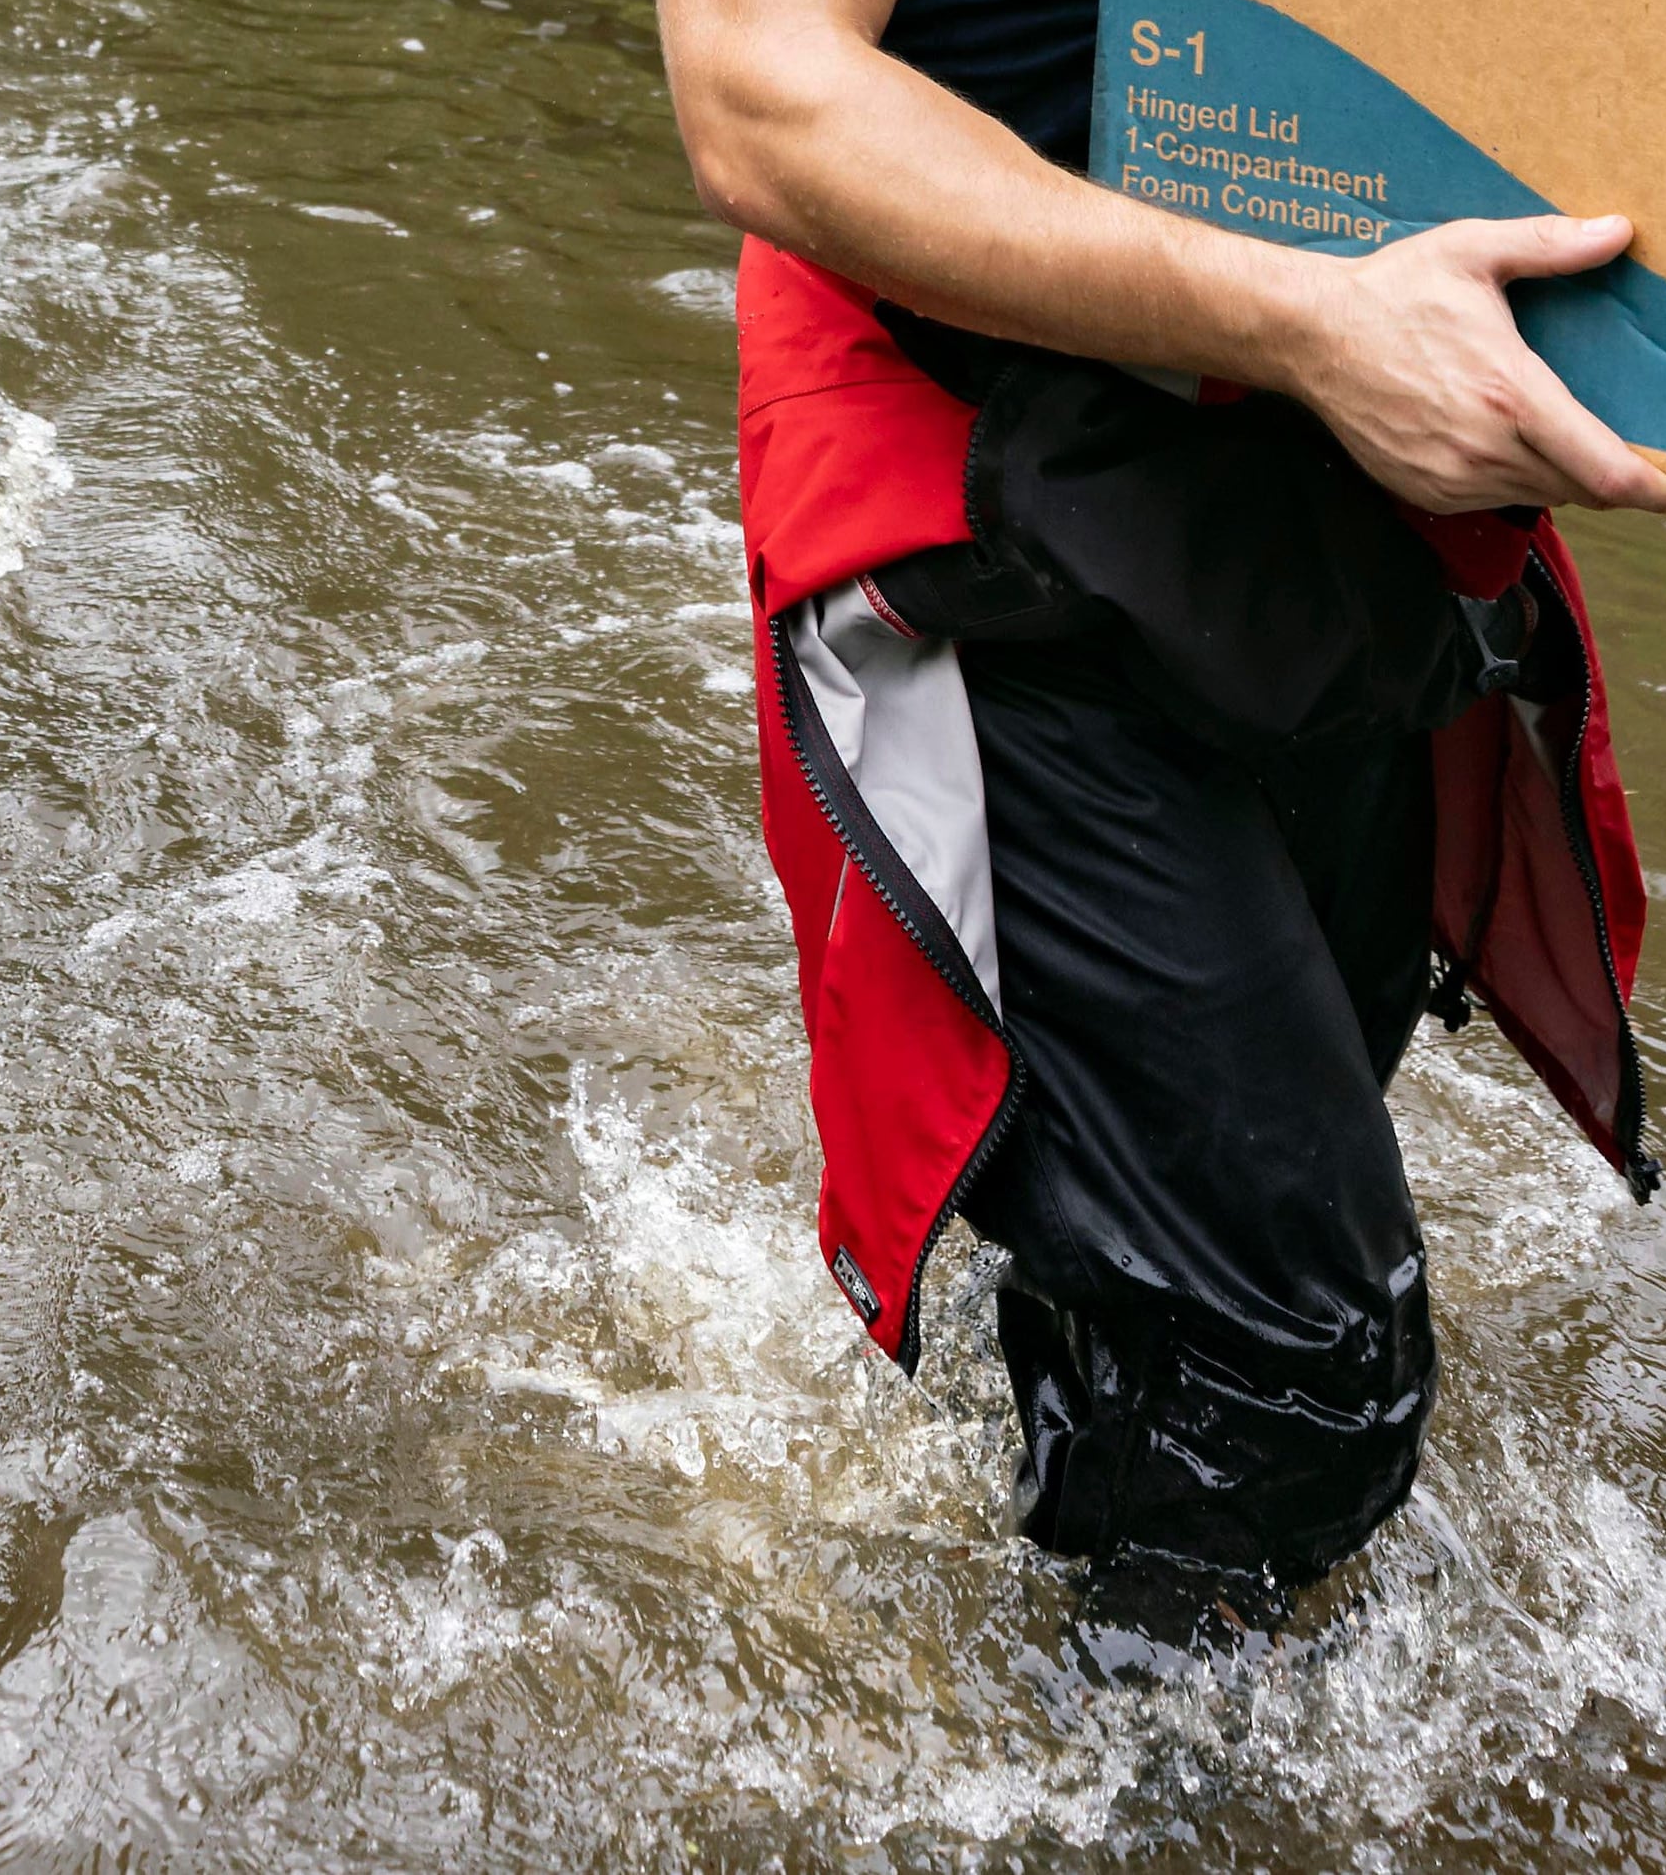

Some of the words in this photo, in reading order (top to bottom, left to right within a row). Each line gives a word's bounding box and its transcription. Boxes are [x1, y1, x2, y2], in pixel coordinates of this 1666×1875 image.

[1129, 19, 1206, 75] S-1
[1126, 86, 1237, 132] Hinged
[1248, 107, 1299, 143] Lid
[1125, 127, 1388, 202] 1-Compartment
[1122, 164, 1210, 208] Foam
[1221, 184, 1390, 243] Container
